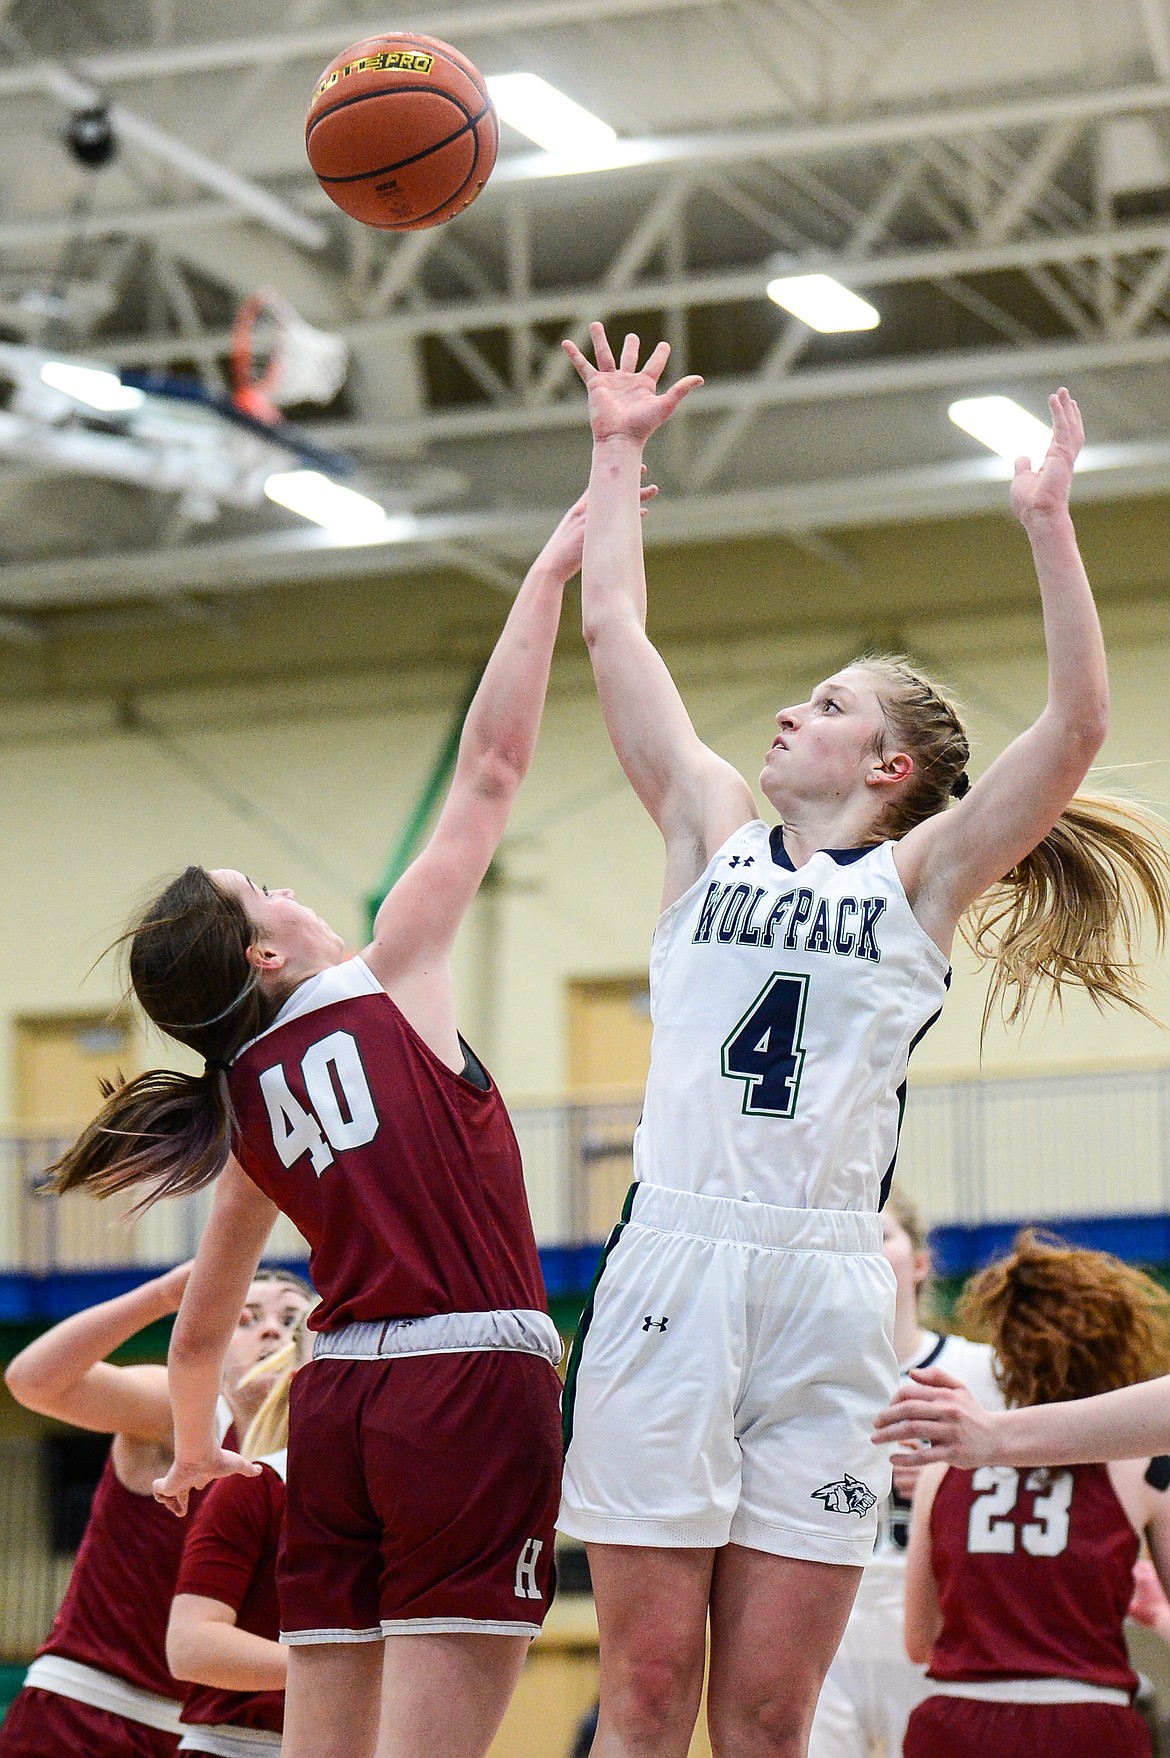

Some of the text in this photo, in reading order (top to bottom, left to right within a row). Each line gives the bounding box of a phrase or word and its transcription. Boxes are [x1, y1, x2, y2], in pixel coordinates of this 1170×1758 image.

[383, 51, 433, 74] PRO
[692, 880, 887, 963] WOLFPACK
[721, 971, 811, 1119] 4
[259, 1030, 380, 1178] 40
[967, 1466, 1074, 1557] 23
[514, 1538, 544, 1600] H
